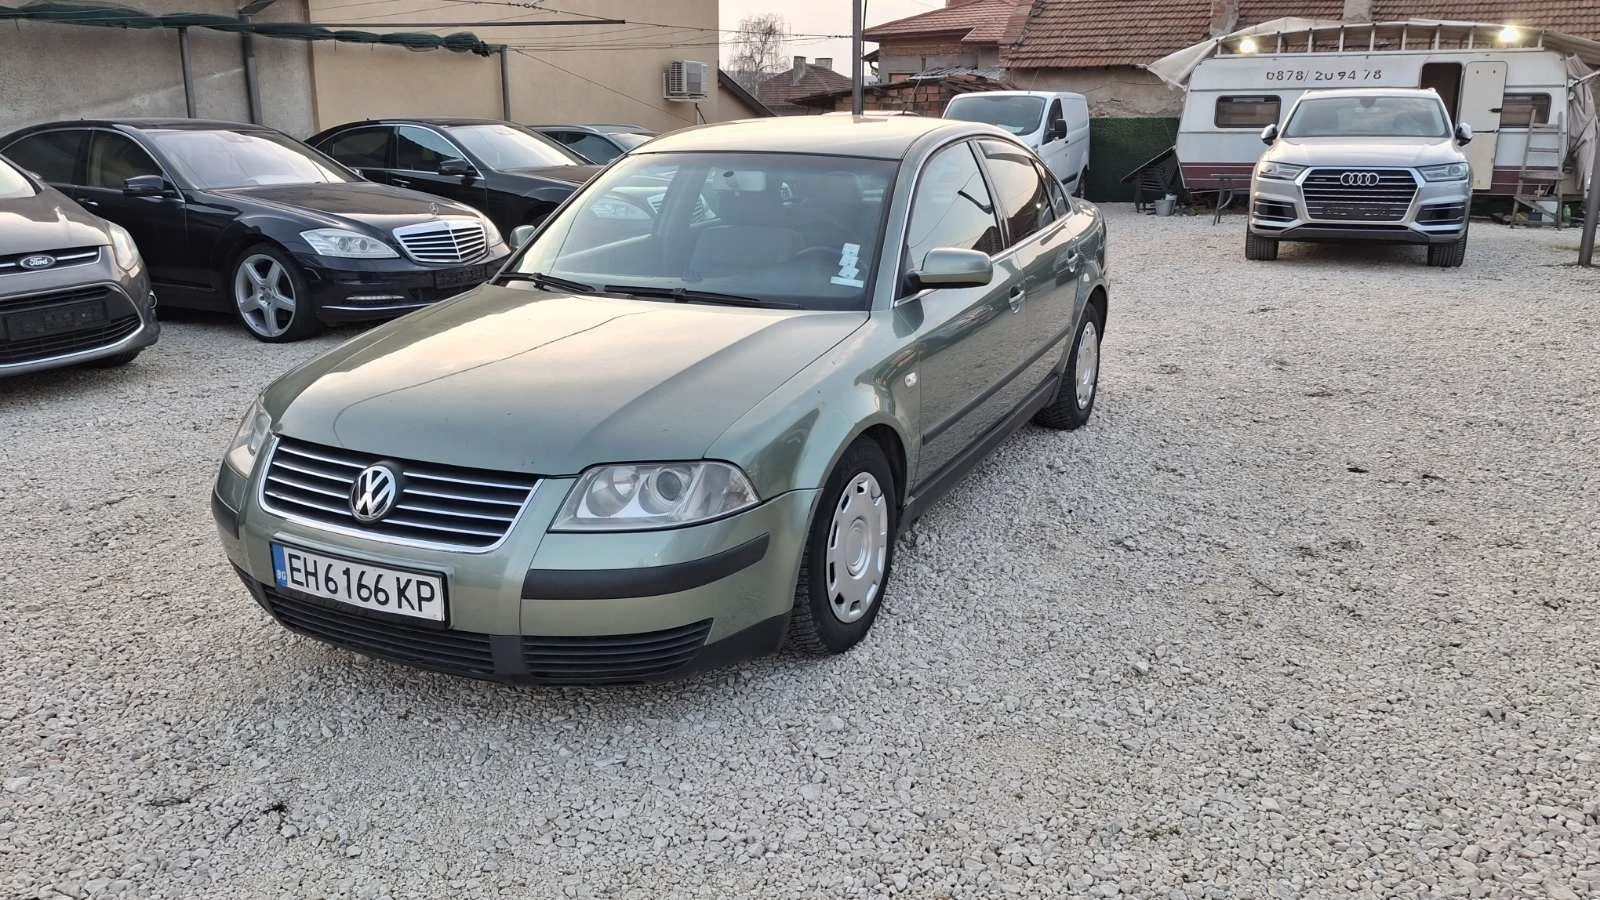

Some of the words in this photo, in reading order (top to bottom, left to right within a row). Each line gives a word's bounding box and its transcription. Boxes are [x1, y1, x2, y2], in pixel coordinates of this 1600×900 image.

[287, 552, 320, 591] EH
[324, 562, 390, 606] 6166
[396, 576, 436, 612] KP
